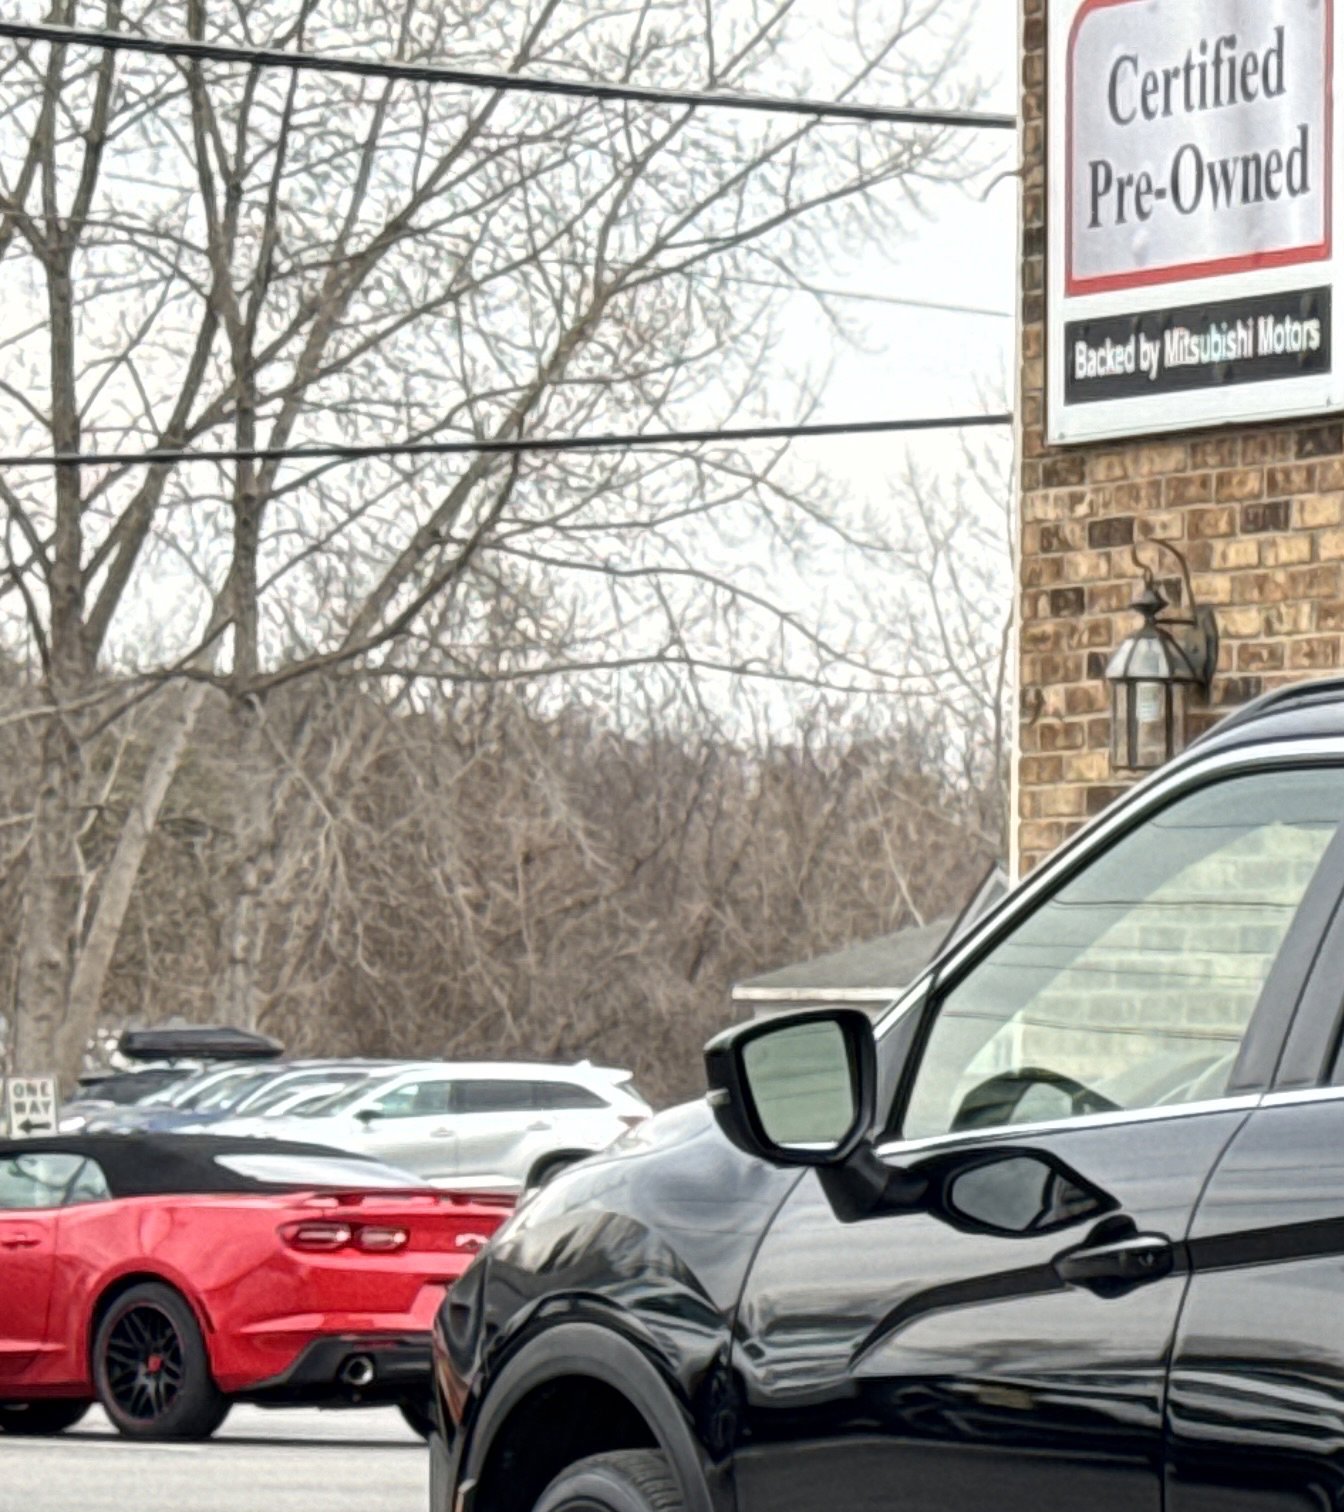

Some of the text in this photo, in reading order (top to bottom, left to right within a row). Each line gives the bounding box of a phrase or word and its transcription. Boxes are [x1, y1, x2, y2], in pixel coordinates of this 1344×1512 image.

[1107, 25, 1287, 127] Certified
[1087, 123, 1312, 230] Pre-Owned
[1074, 314, 1321, 381] Backed by Mitsubishi Motors
[13, 1081, 51, 1099] ONE
